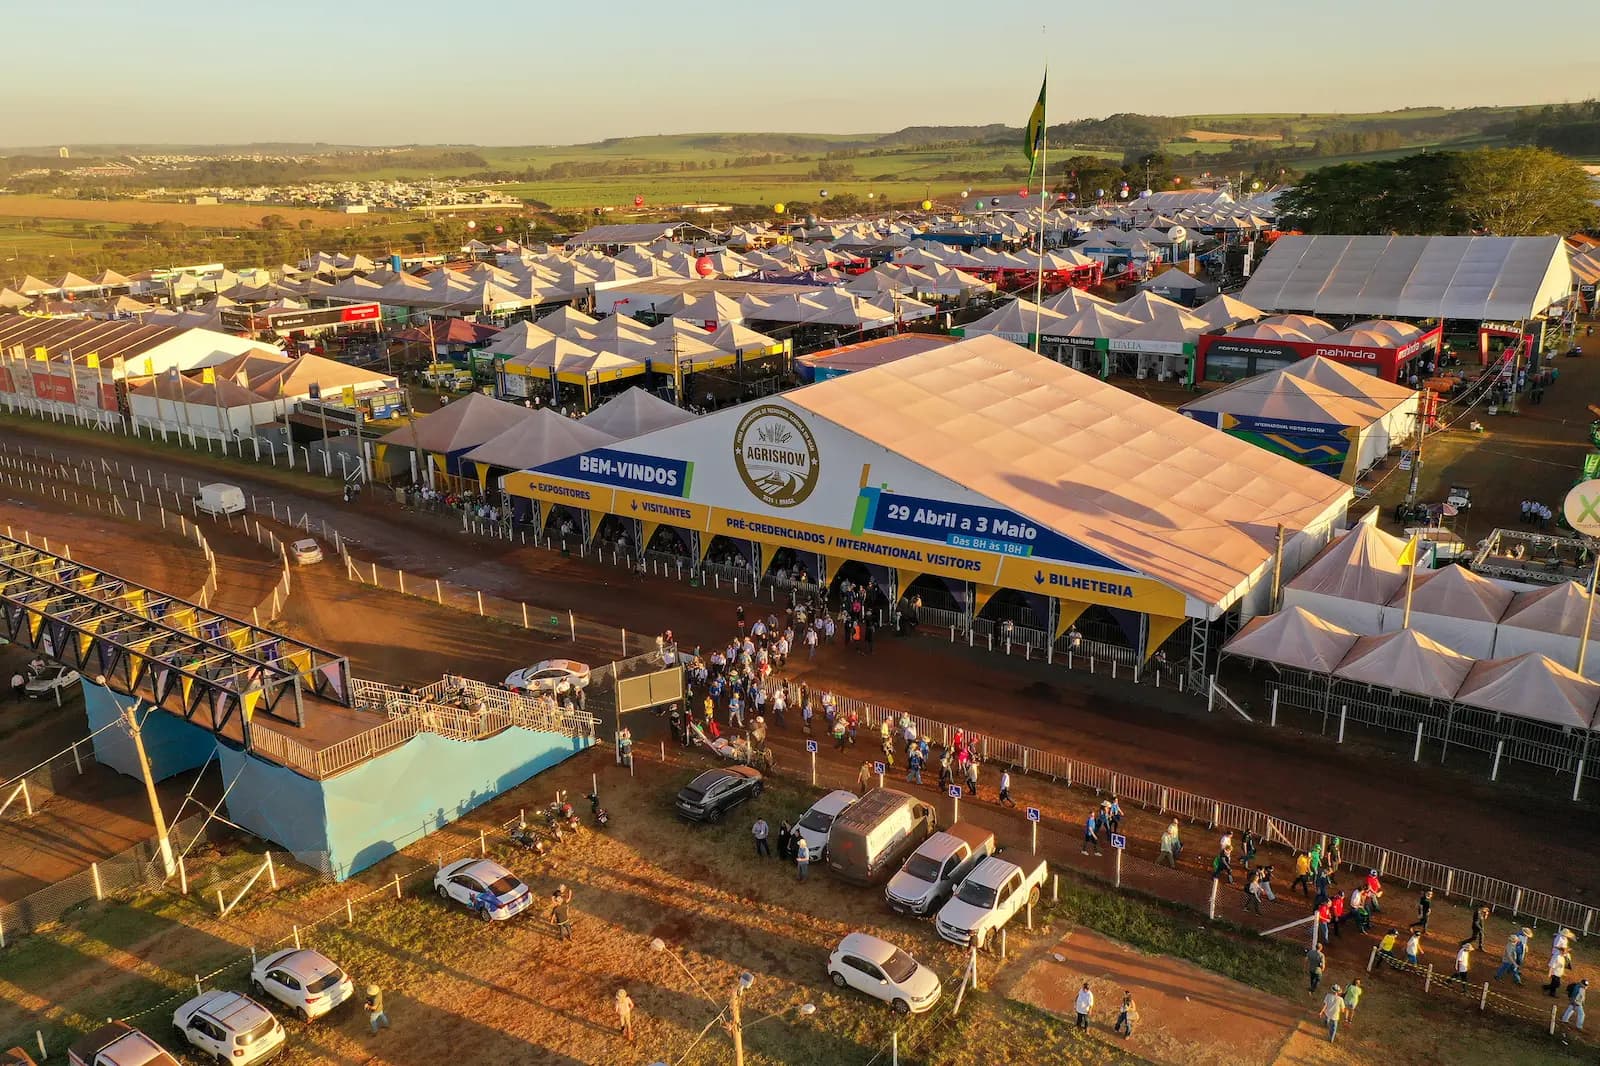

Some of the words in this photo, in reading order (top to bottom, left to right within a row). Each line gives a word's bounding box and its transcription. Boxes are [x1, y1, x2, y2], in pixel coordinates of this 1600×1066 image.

[1042, 335, 1069, 344] Pavilhão
[1070, 336, 1095, 346] Italiano
[1316, 348, 1376, 360] mahindra
[747, 446, 806, 467] AGRISHOW
[580, 455, 677, 487] BEM-VINDOS
[538, 483, 591, 500] EXPOSITORES
[642, 502, 692, 519] VISITANTES
[887, 504, 910, 521] 29
[913, 508, 956, 529] Abril
[960, 516, 971, 531] a
[976, 516, 988, 533] 3
[992, 519, 1037, 541] Maio
[726, 517, 826, 545] PRÉ-CREDENCIADOS
[836, 537, 923, 562] INTERNATIONAL
[926, 553, 981, 571] VISITORS
[952, 535, 970, 548] Das
[973, 538, 987, 550] 8H
[1003, 543, 1023, 555] 18H
[1049, 573, 1133, 598] BILHETERIA
